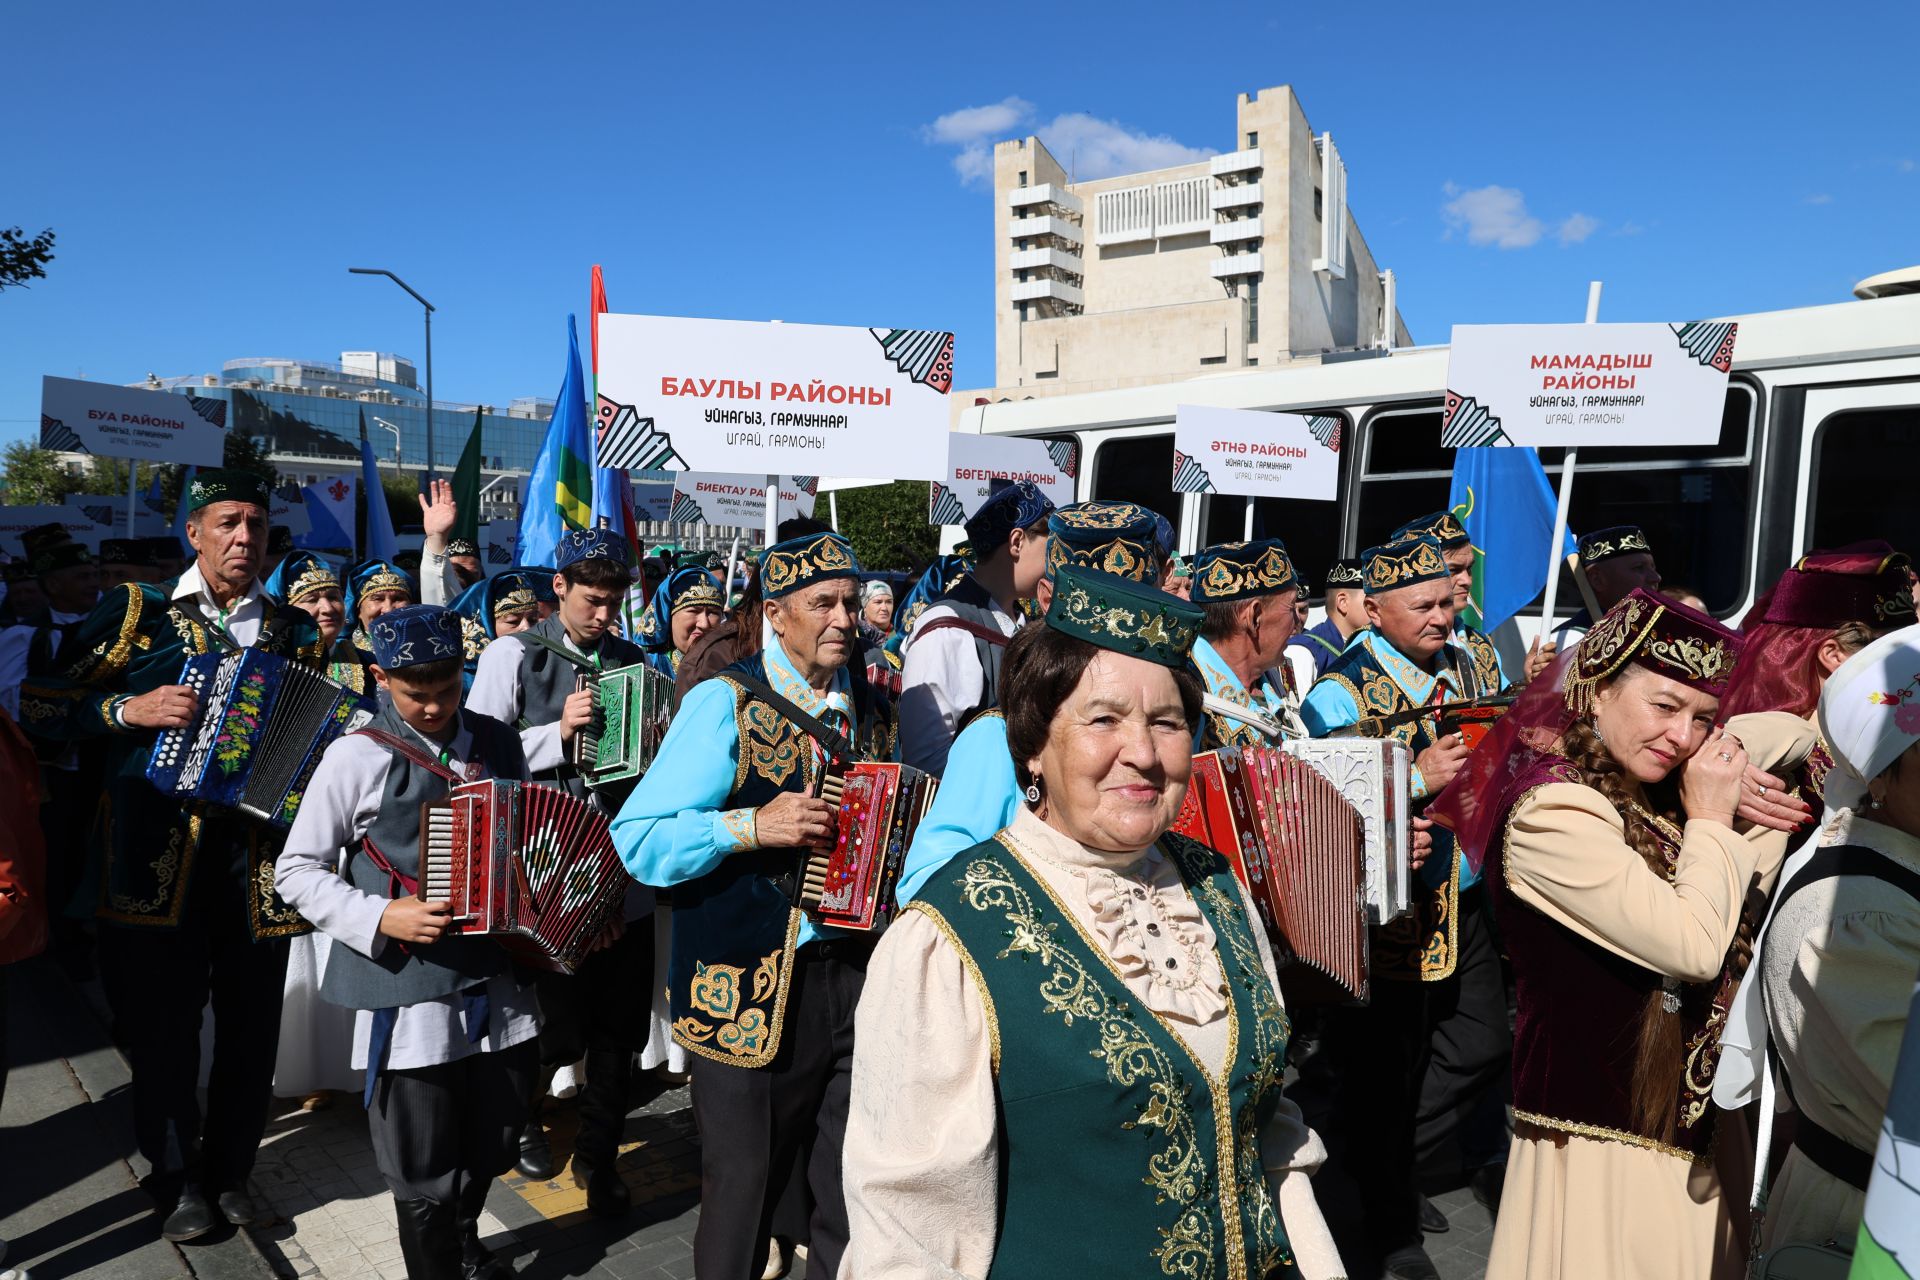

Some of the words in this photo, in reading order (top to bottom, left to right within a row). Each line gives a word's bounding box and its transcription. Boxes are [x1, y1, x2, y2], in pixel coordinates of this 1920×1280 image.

[1530, 354, 1652, 371] МАМАДЫШ
[1543, 372, 1636, 390] РАЙОНЫ
[661, 376, 761, 400] БАУЛЫ
[770, 379, 892, 406] РАЙОНЫ
[1529, 395, 1578, 408] УЙНАГЫЗ,
[88, 409, 117, 422] БУА
[121, 413, 185, 430] РАЙОНЫ
[704, 408, 766, 427] УЙНАГЫЗ,
[1545, 413, 1575, 426] ИГРАЙ,
[1578, 413, 1625, 424] ГАРМОНЬ!
[726, 432, 764, 448] ИГРАЙ,
[768, 434, 825, 449] ГАРМОНЬ!
[1211, 440, 1247, 453] ӘТНӘ
[1250, 442, 1307, 459] РАЙОНЫ
[1011, 470, 1056, 485] РАЙОНЫ
[696, 482, 747, 495] БИЕКТАУ
[750, 487, 798, 501] РАНЫ
